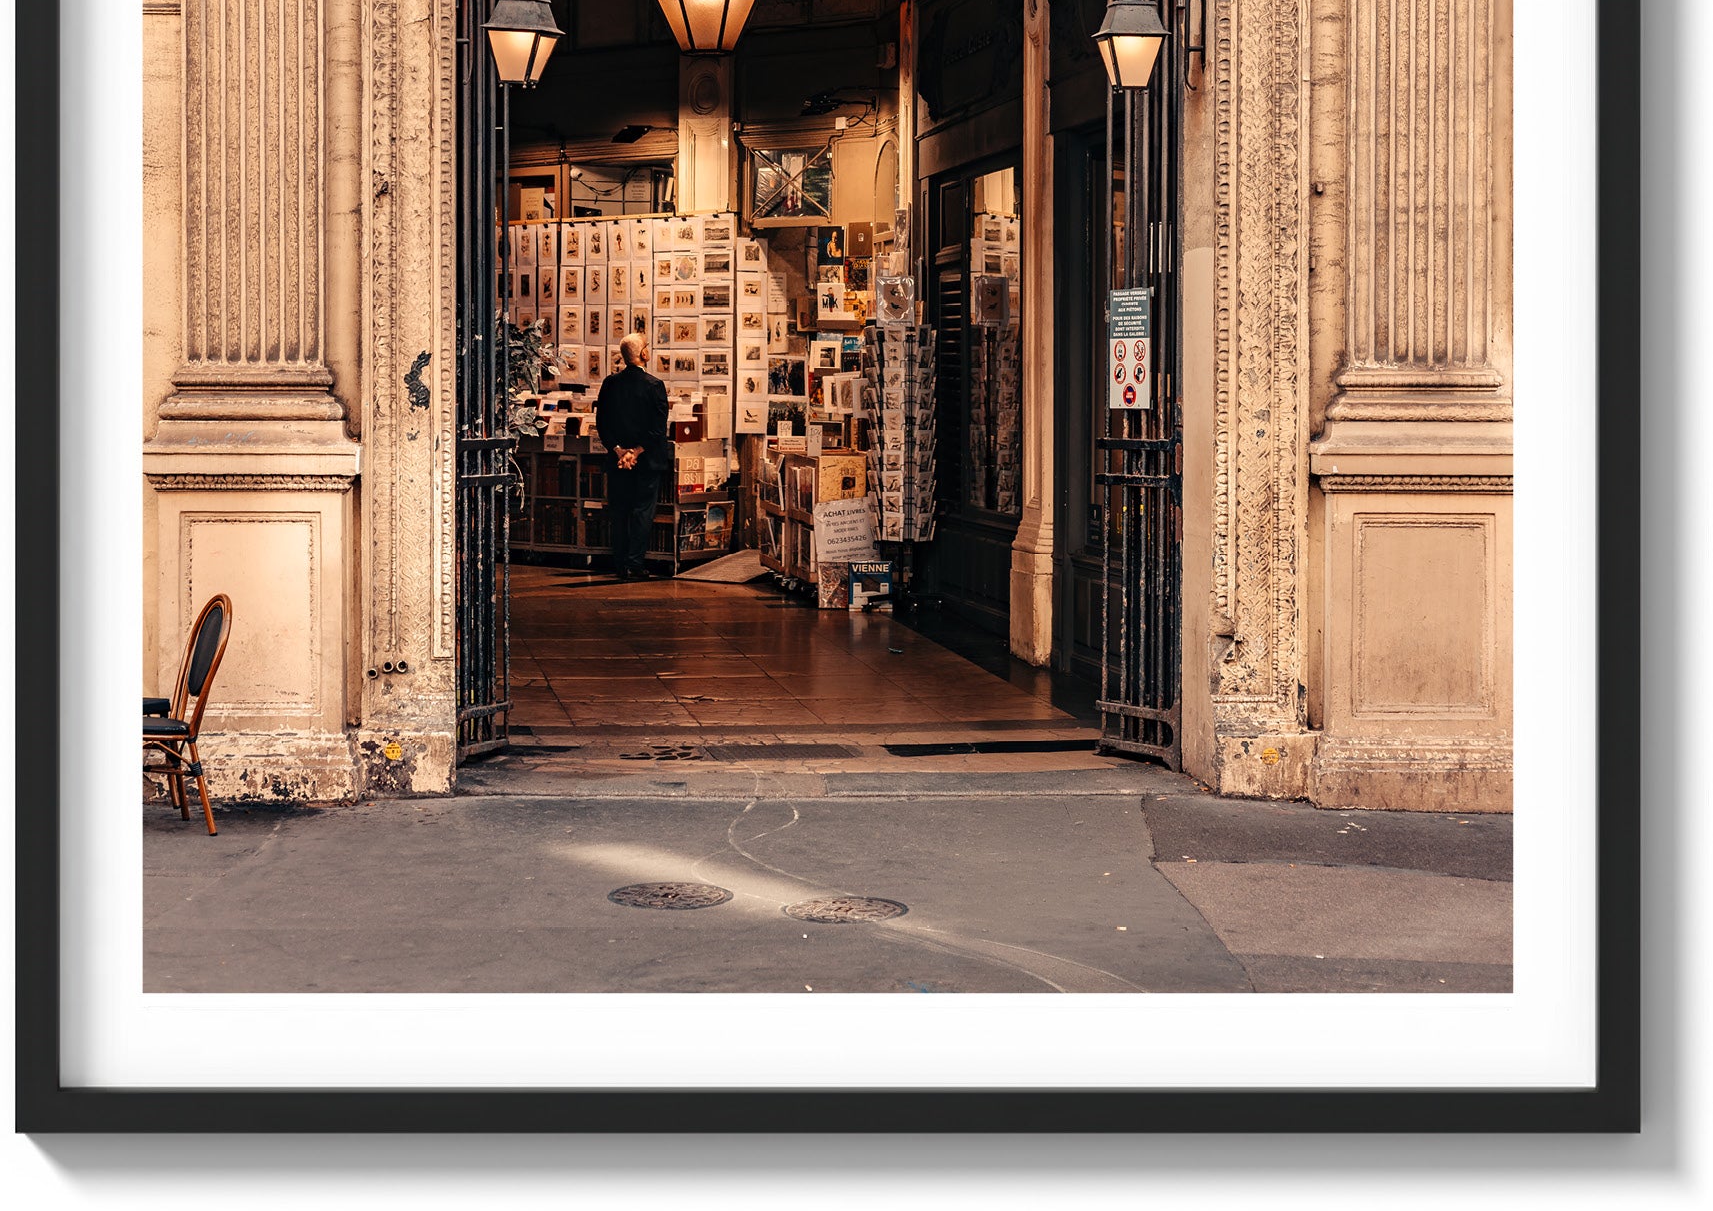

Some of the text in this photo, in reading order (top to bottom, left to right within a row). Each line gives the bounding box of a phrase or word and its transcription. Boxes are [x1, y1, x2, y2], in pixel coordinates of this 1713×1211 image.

[823, 508, 866, 518] ACHAT LIVRES
[852, 564, 889, 573] VIENNE
